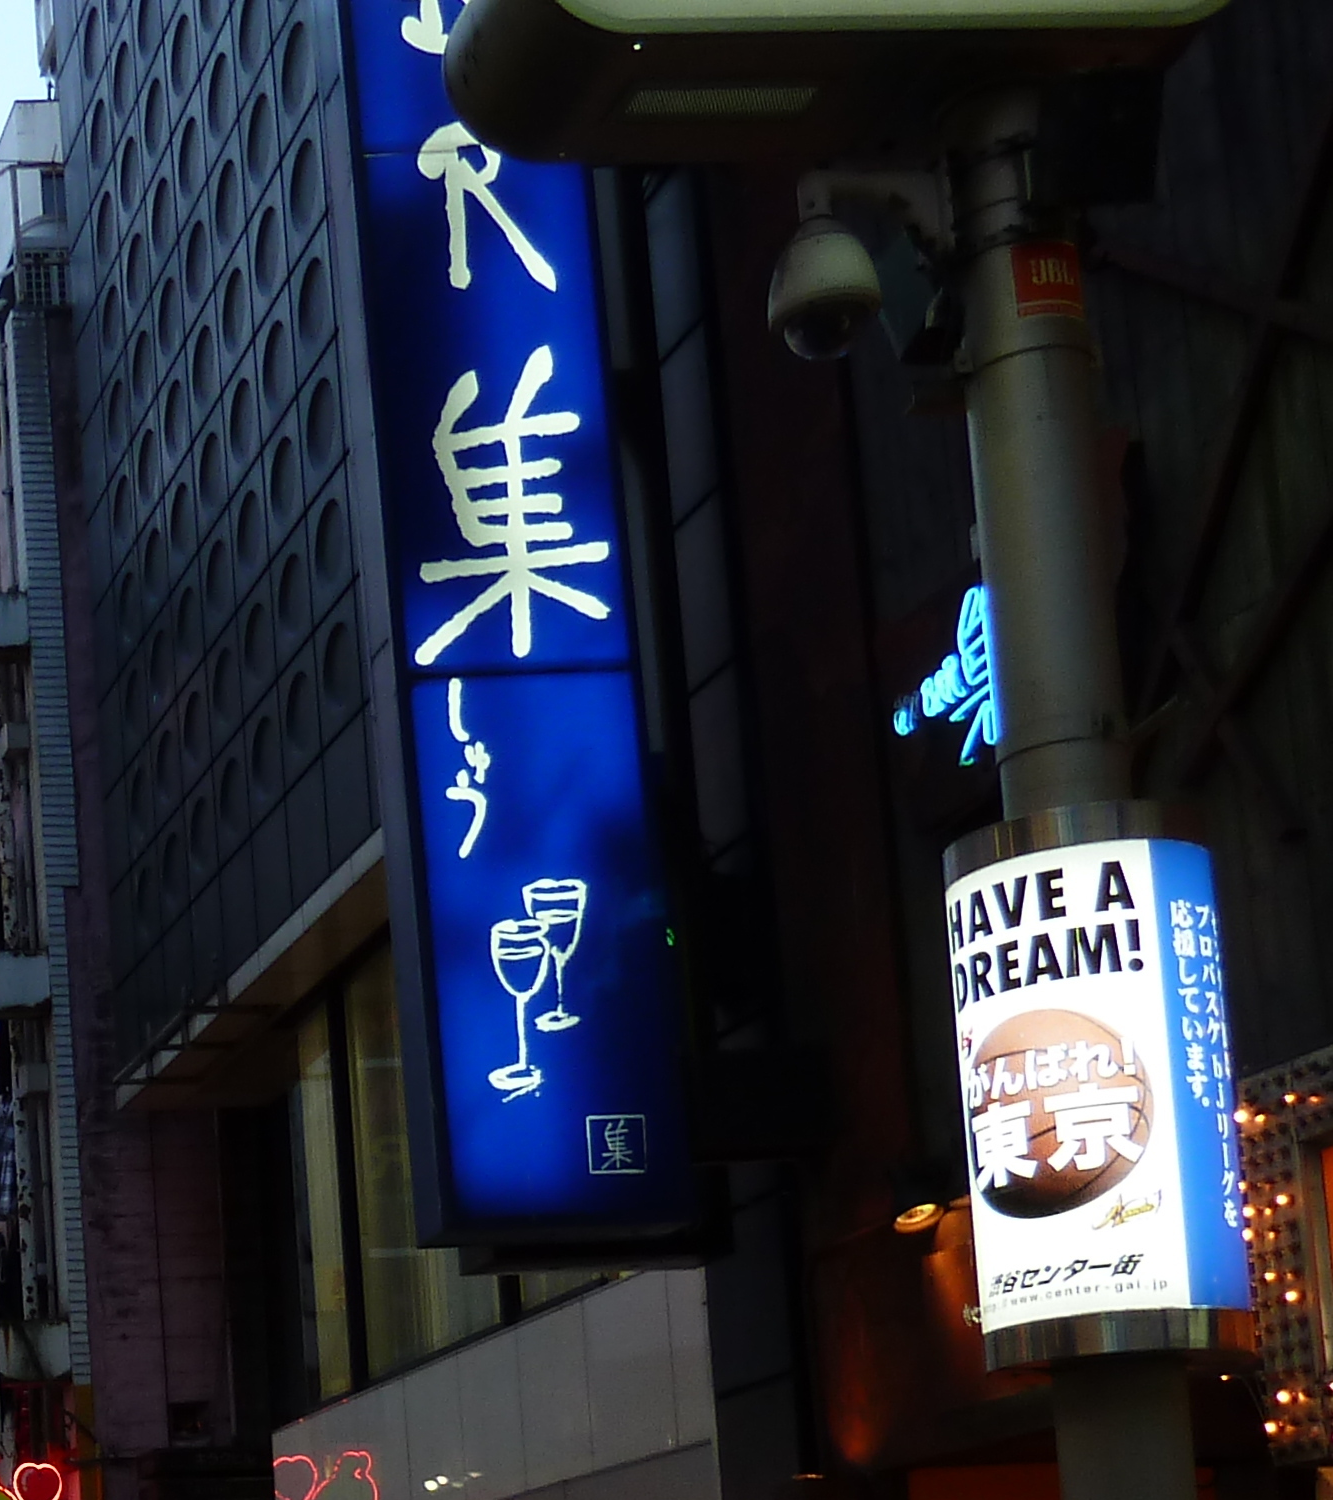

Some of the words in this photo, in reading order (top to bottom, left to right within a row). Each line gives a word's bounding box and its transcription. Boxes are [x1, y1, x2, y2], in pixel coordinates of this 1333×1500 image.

[416, 345, 609, 665] 集
[948, 865, 1067, 955] HAVE
[1094, 860, 1135, 913] A
[953, 917, 1145, 1017] DREAM!
[1169, 898, 1211, 1109] 応援しています。
[967, 1033, 1138, 1110] がんばれ!
[971, 1080, 1146, 1191] 東京
